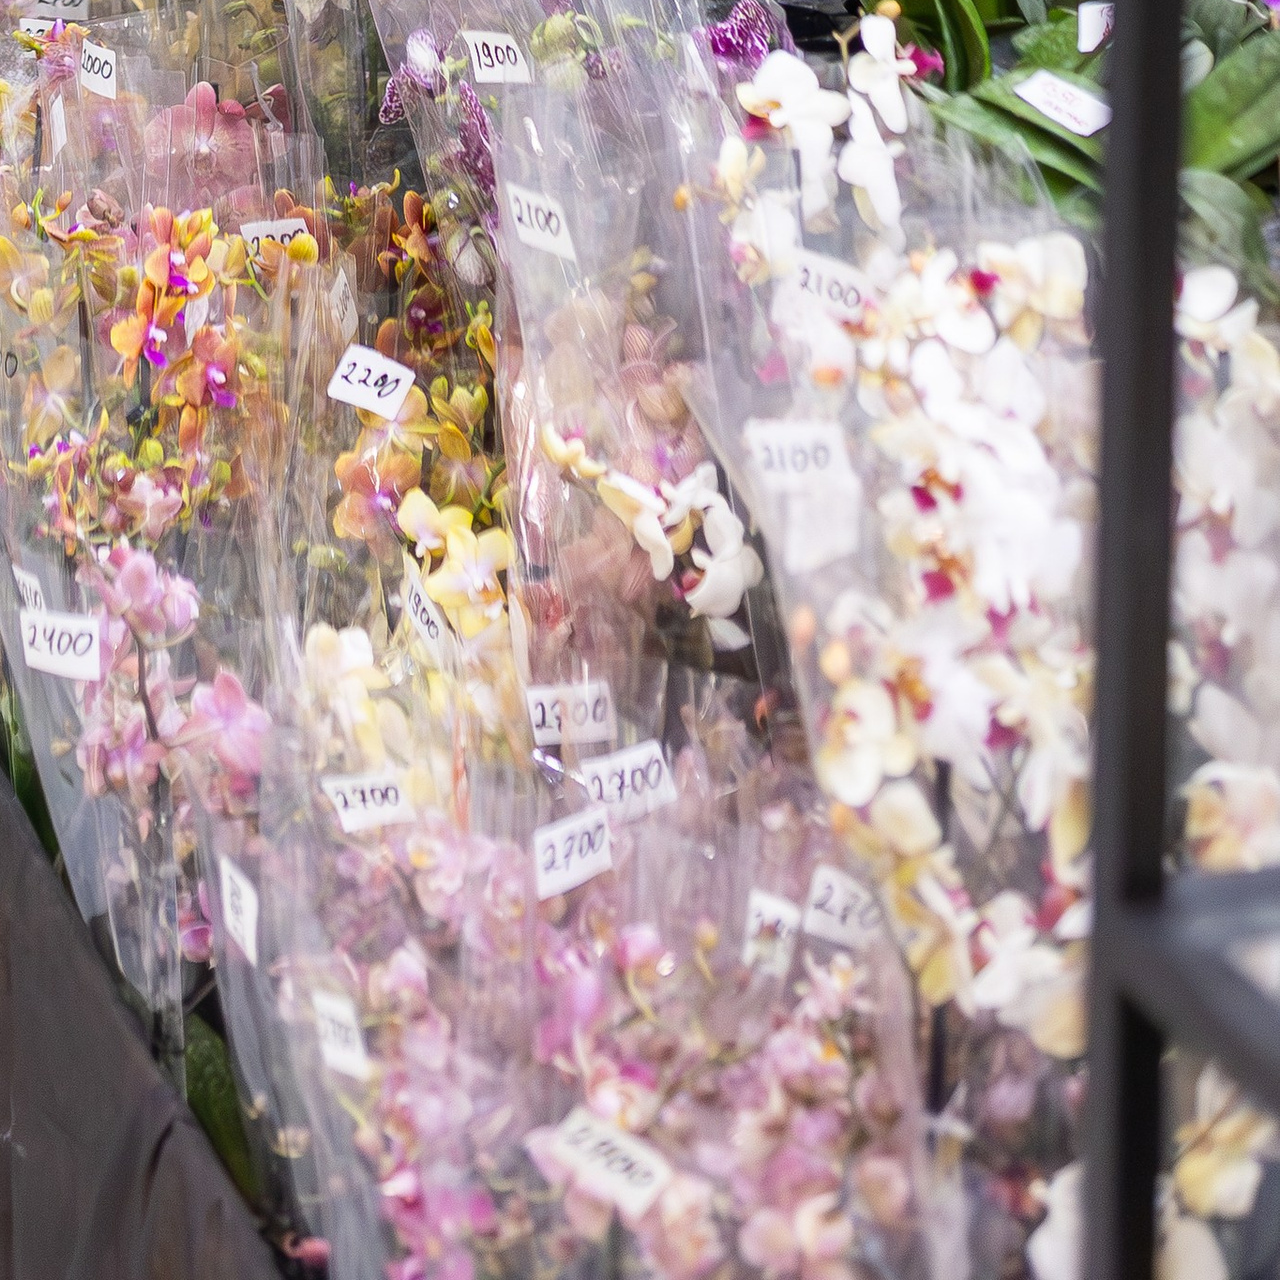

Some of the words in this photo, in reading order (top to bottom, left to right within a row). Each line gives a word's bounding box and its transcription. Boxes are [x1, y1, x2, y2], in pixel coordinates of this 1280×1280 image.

[474, 41, 518, 70] 1900
[513, 194, 560, 238] 2100
[798, 266, 861, 308] 2100
[28, 624, 94, 657] 2400
[335, 785, 400, 810] 2700
[591, 757, 663, 804] 2700
[543, 823, 605, 873] 2700
